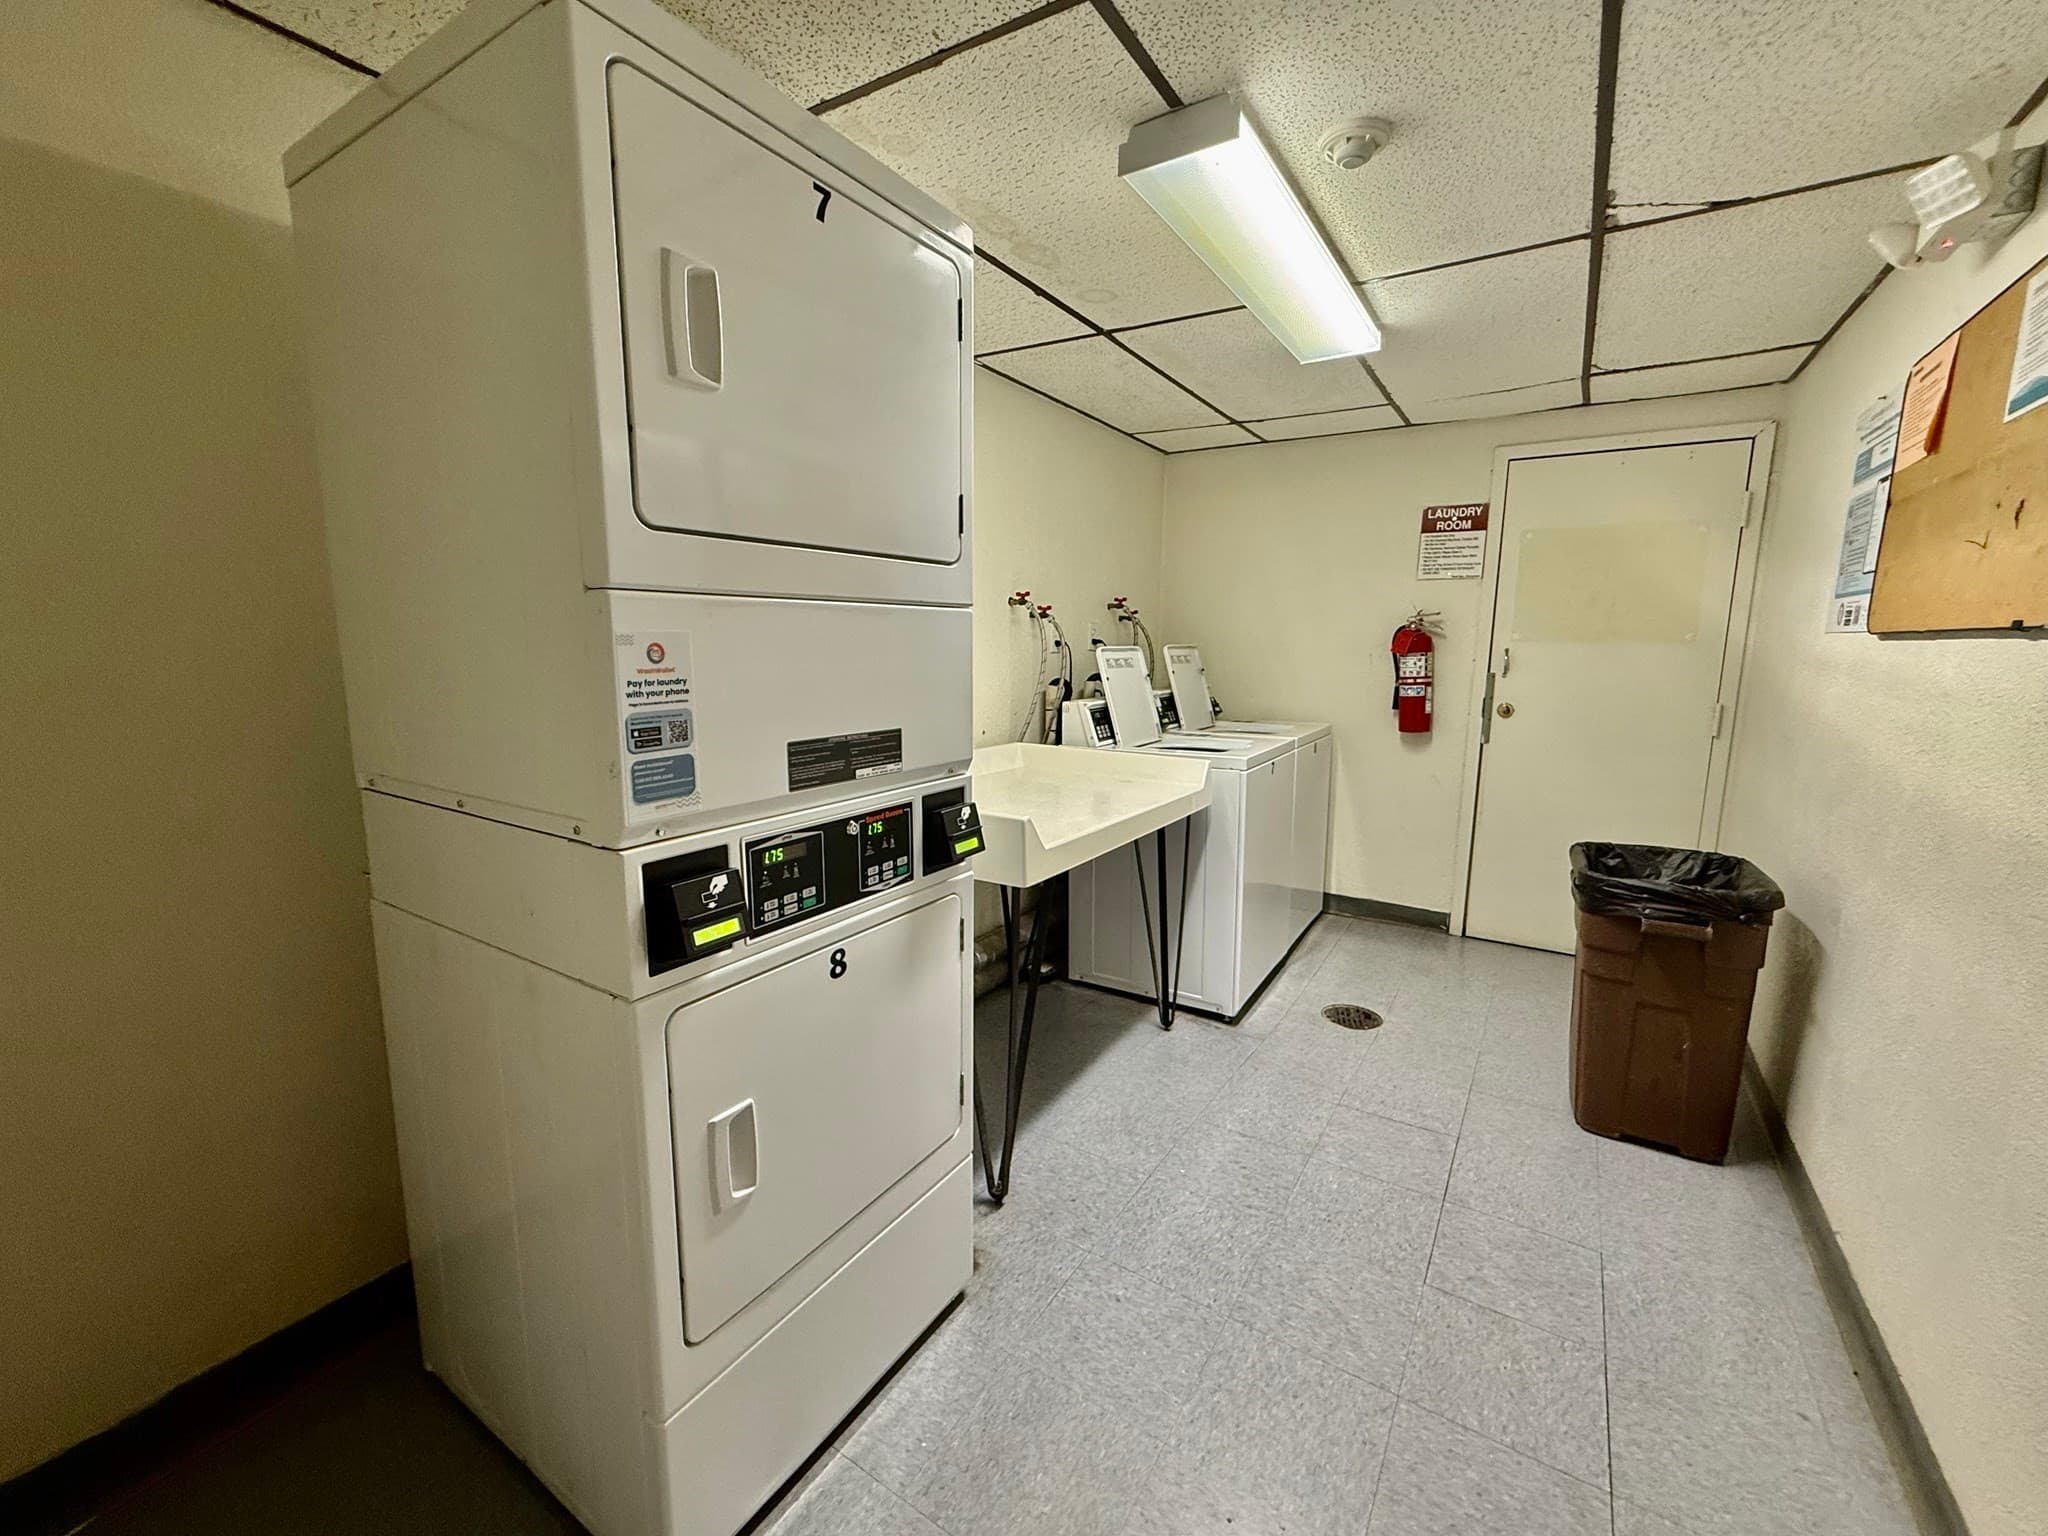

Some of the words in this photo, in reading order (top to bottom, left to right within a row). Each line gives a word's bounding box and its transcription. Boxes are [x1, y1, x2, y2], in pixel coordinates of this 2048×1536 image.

[813, 180, 832, 223] 7
[1428, 506, 1483, 518] LAUNDRY
[1436, 520, 1472, 531] ROOM
[627, 680, 643, 689] Pay
[644, 679, 655, 687] for
[657, 678, 687, 687] laundry
[625, 690, 644, 698] with
[645, 690, 664, 699] your
[665, 688, 690, 698] phone
[830, 948, 847, 979] 8
